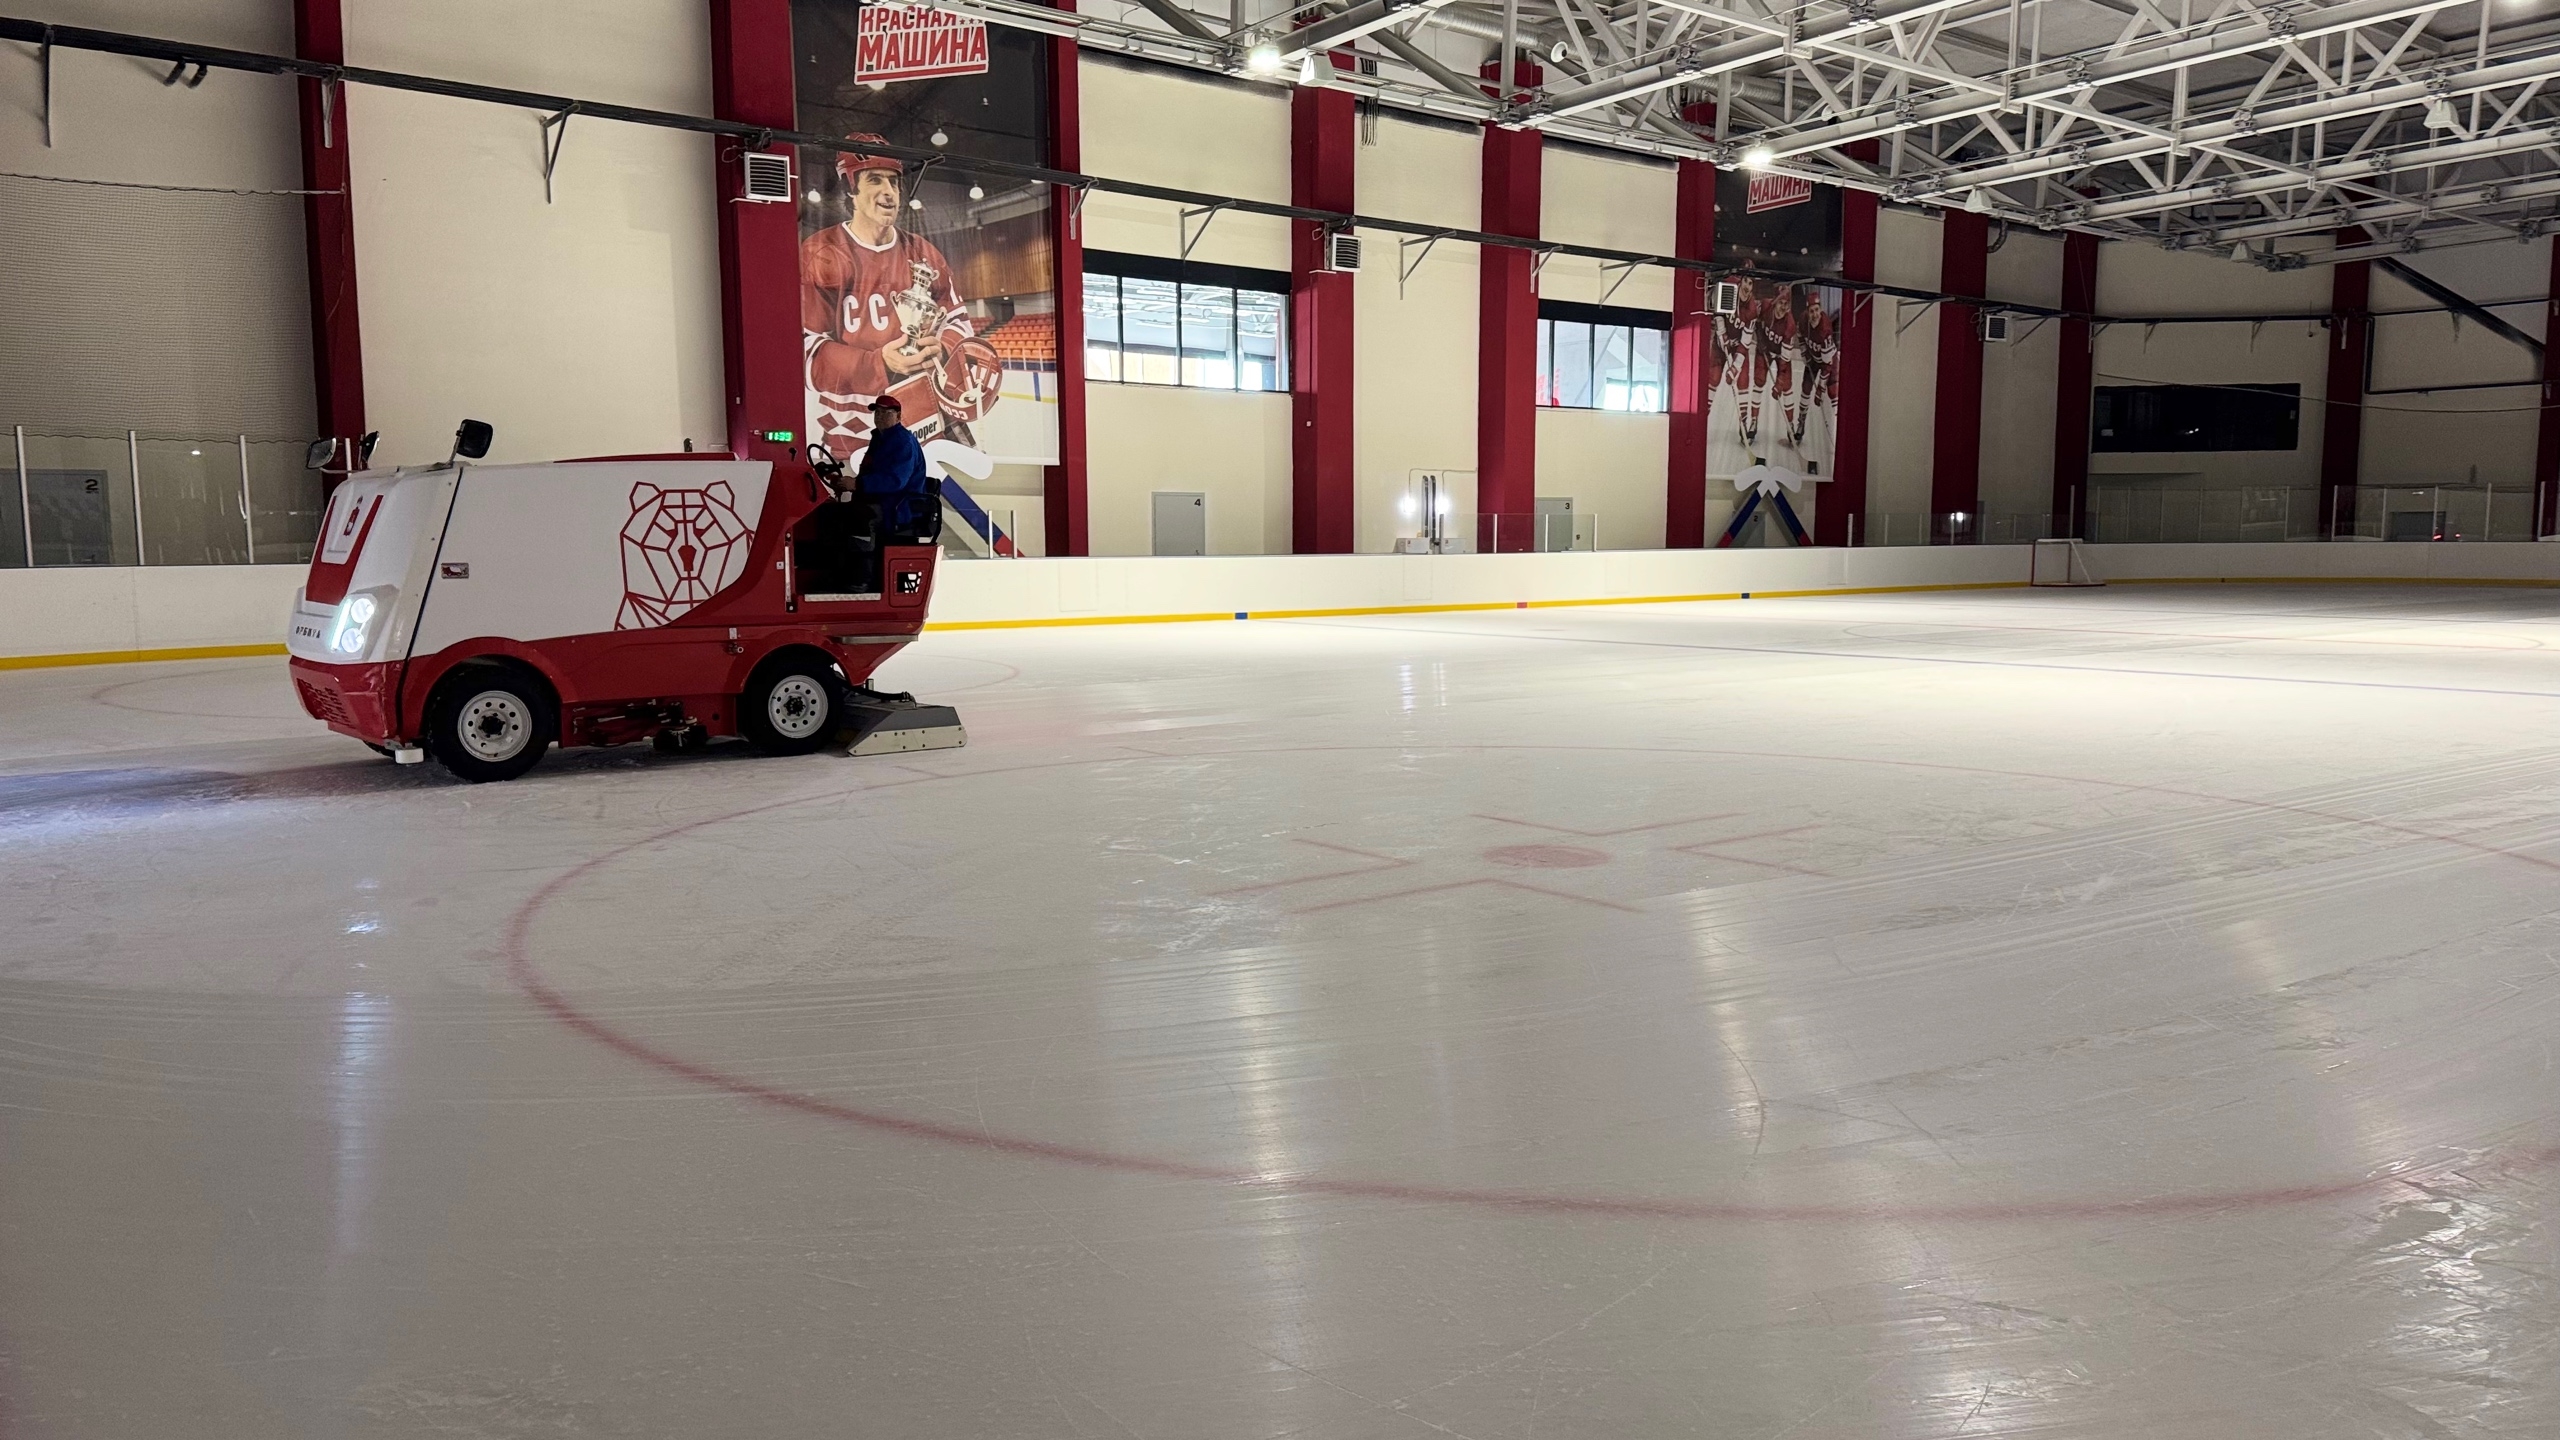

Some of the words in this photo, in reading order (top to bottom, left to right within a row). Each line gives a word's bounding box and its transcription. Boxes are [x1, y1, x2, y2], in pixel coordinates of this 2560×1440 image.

[861, 6, 957, 33] КРАСНАЯ
[857, 26, 987, 71] МАШИНА
[1749, 174, 1811, 205] МАШИНА
[843, 293, 888, 333] СС
[911, 420, 938, 440] ooper
[85, 479, 98, 491] 2
[1194, 498, 1201, 506] 4
[1564, 502, 1570, 510] 3
